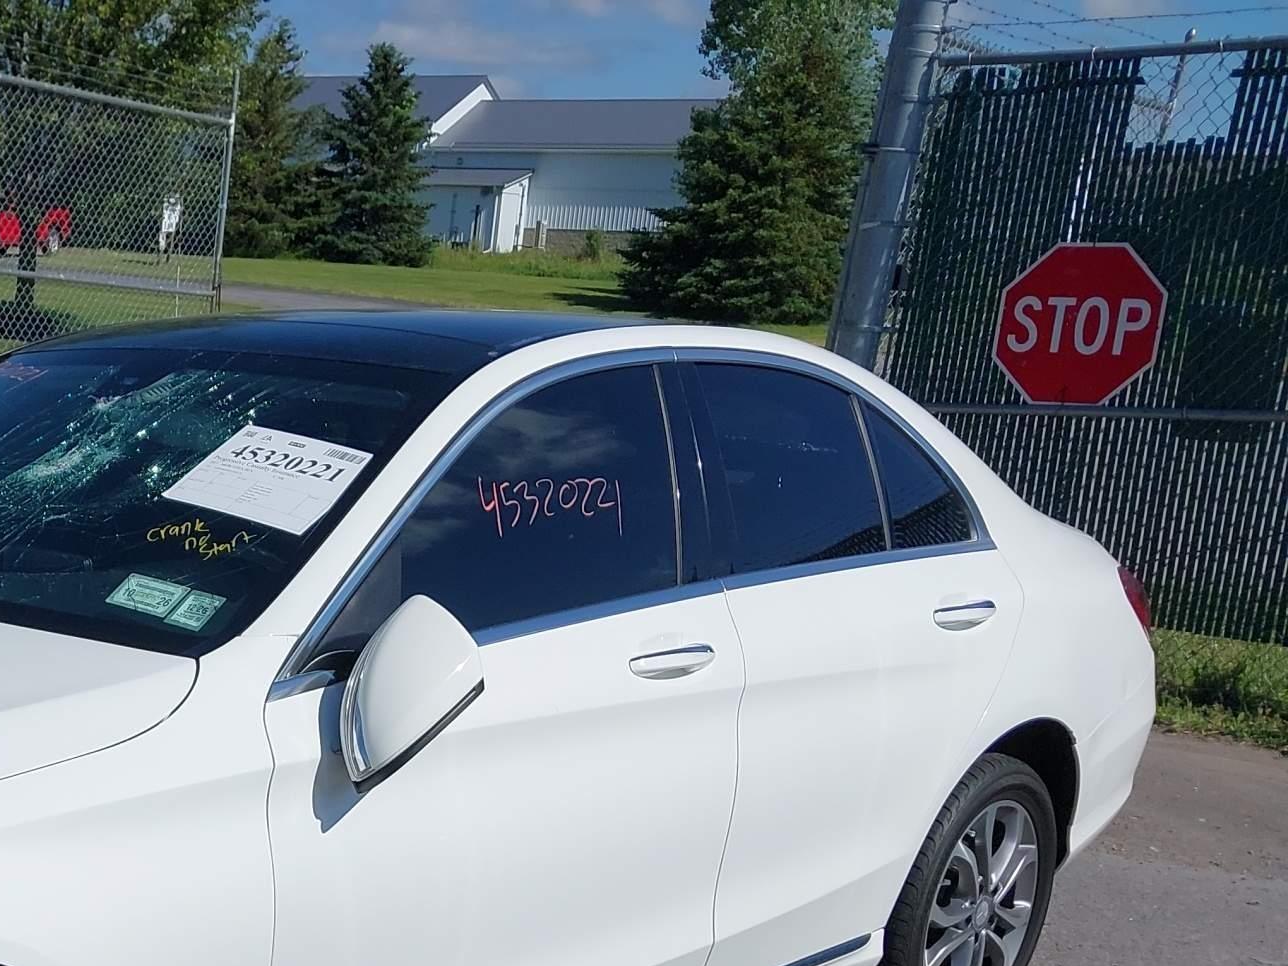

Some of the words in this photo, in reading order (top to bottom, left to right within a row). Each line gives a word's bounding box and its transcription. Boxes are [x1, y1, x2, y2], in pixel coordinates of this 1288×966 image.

[1006, 295, 1152, 355] STOP
[230, 444, 346, 482] 45320221
[476, 475, 623, 537] 45320221
